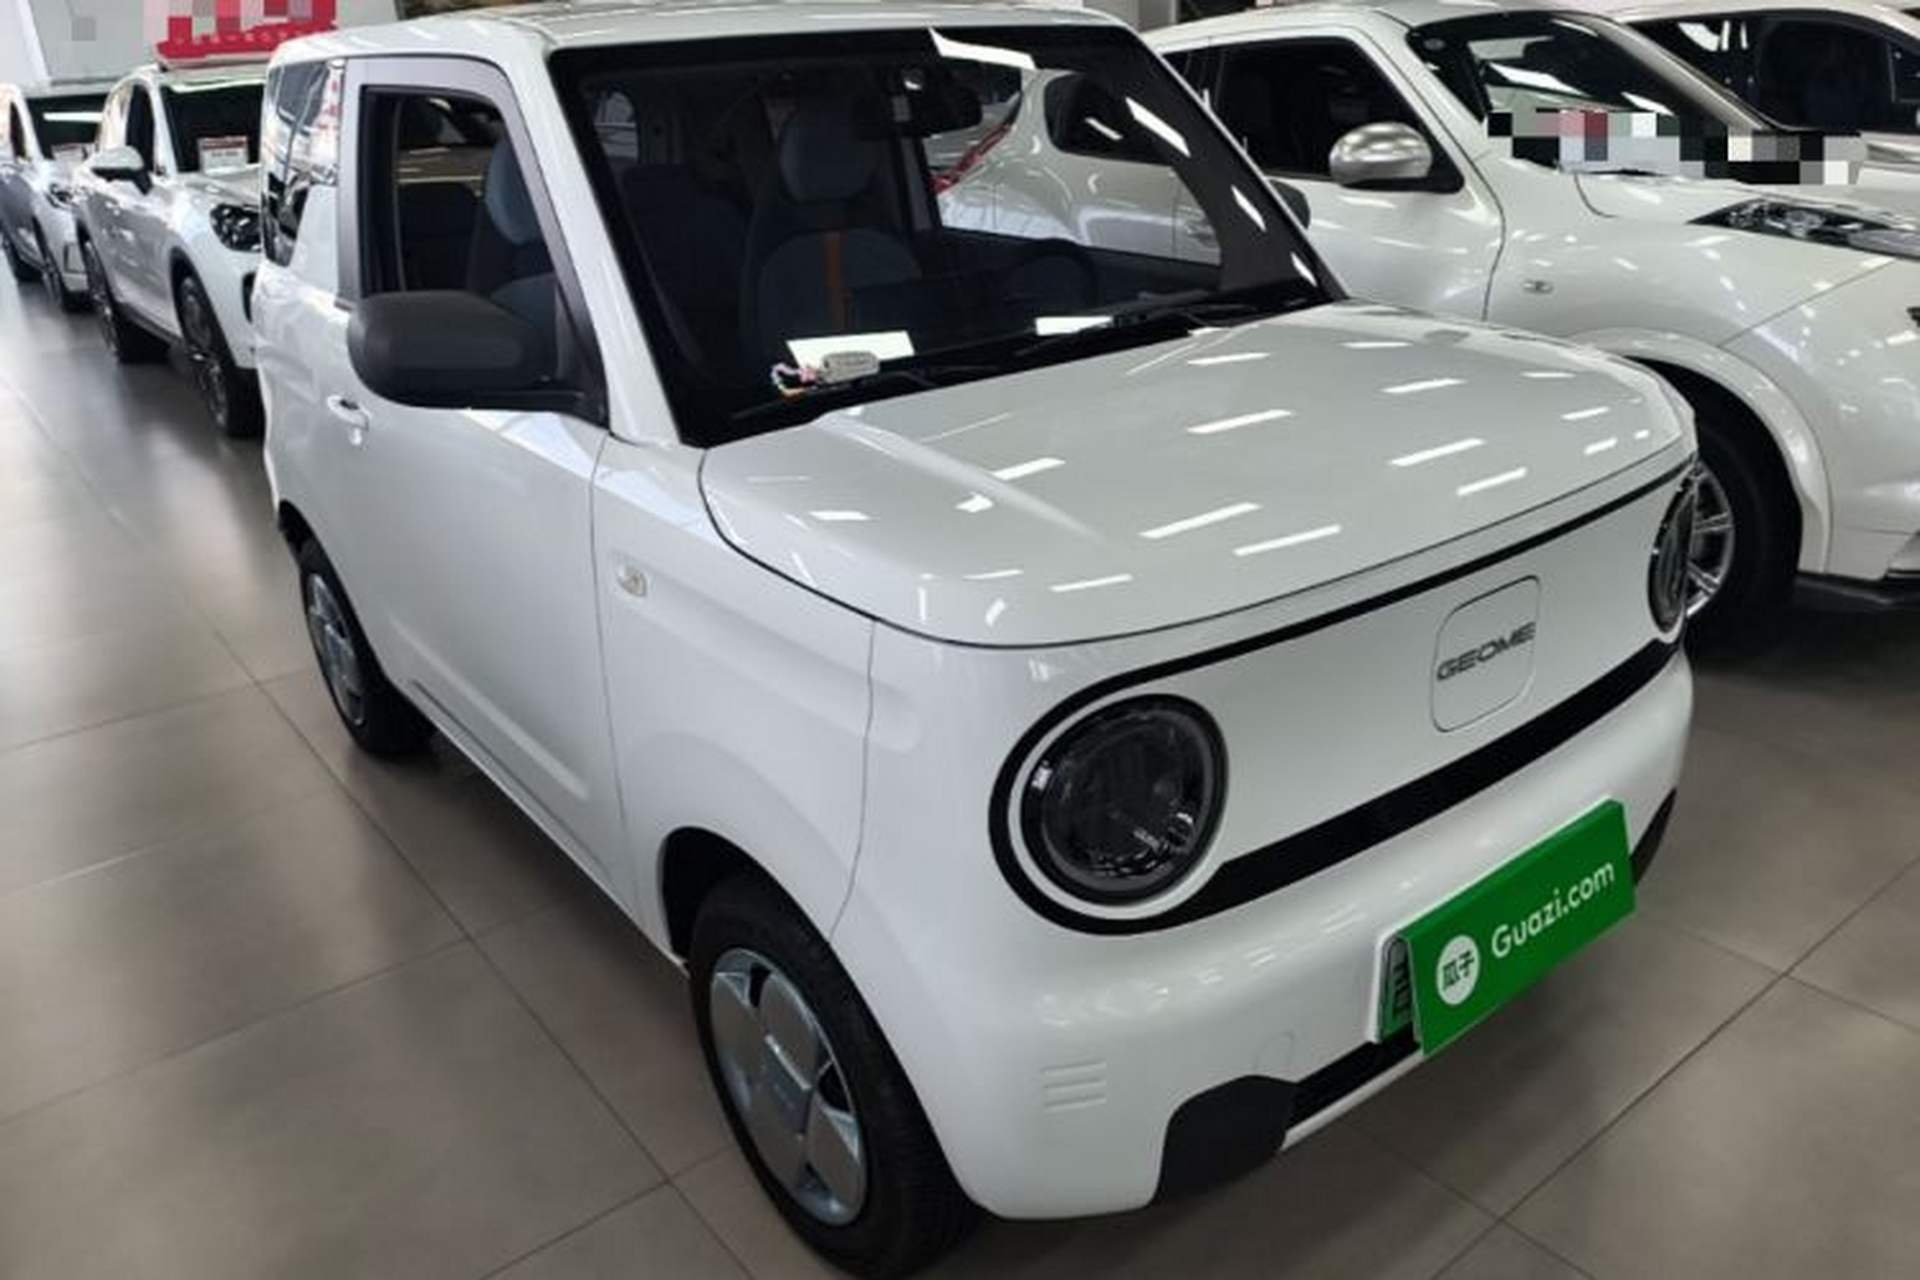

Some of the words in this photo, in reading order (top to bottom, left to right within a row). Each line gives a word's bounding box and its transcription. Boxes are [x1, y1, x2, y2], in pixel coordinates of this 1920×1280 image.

[1437, 621, 1536, 680] GEOME
[1491, 862, 1615, 958] Guazi.com
[1442, 949, 1476, 991] 瓜子
